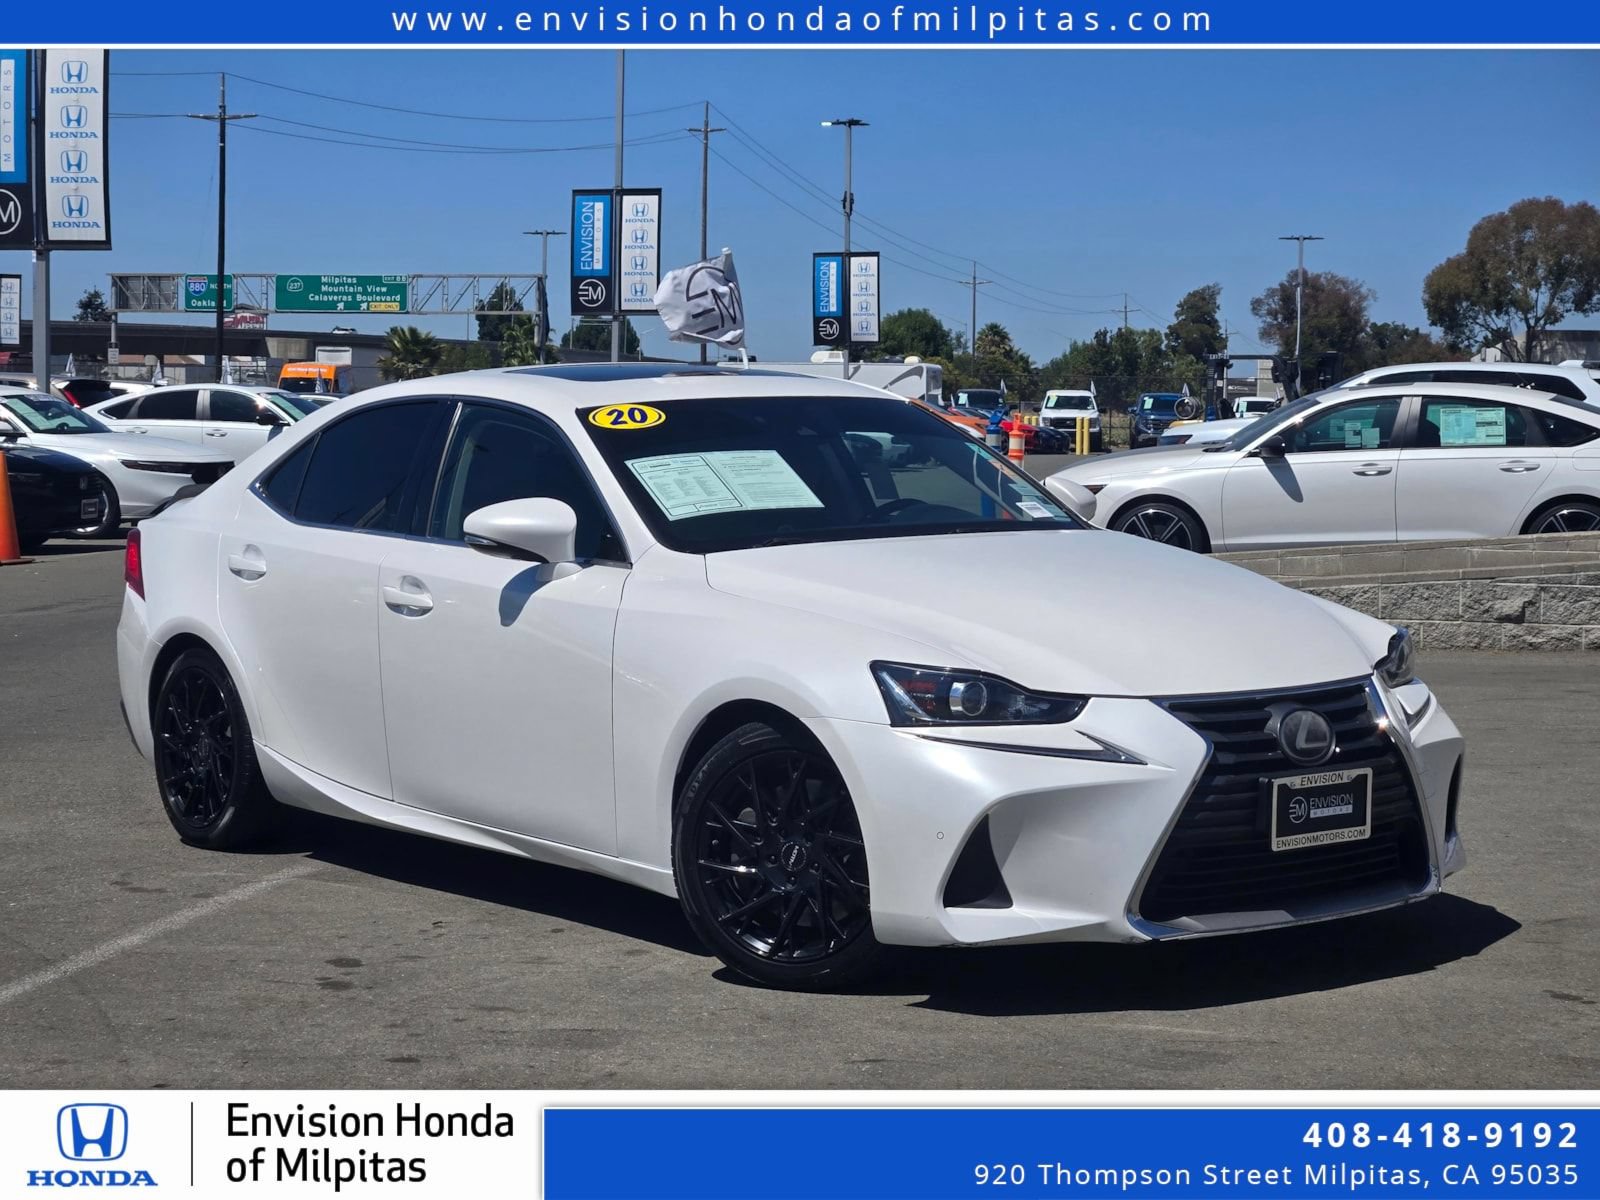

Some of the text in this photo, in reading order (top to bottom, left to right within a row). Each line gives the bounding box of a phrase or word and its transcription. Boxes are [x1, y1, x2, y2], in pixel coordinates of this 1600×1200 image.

[3, 69, 12, 162] MOTORS
[581, 202, 594, 270] ENVISION
[189, 282, 206, 291] 880
[321, 276, 357, 285] Milpitas
[820, 262, 830, 312] ENVISION
[321, 284, 388, 292] Mountain View
[191, 299, 227, 307] Oaklad
[308, 293, 401, 301] Calaveras Boulevard
[606, 408, 648, 426] 20
[1300, 772, 1344, 786] ENVISION
[1310, 793, 1353, 809] ENVISION
[1313, 807, 1350, 816] MOTORS
[1276, 829, 1366, 849] ENVISIONMOTORS.COM
